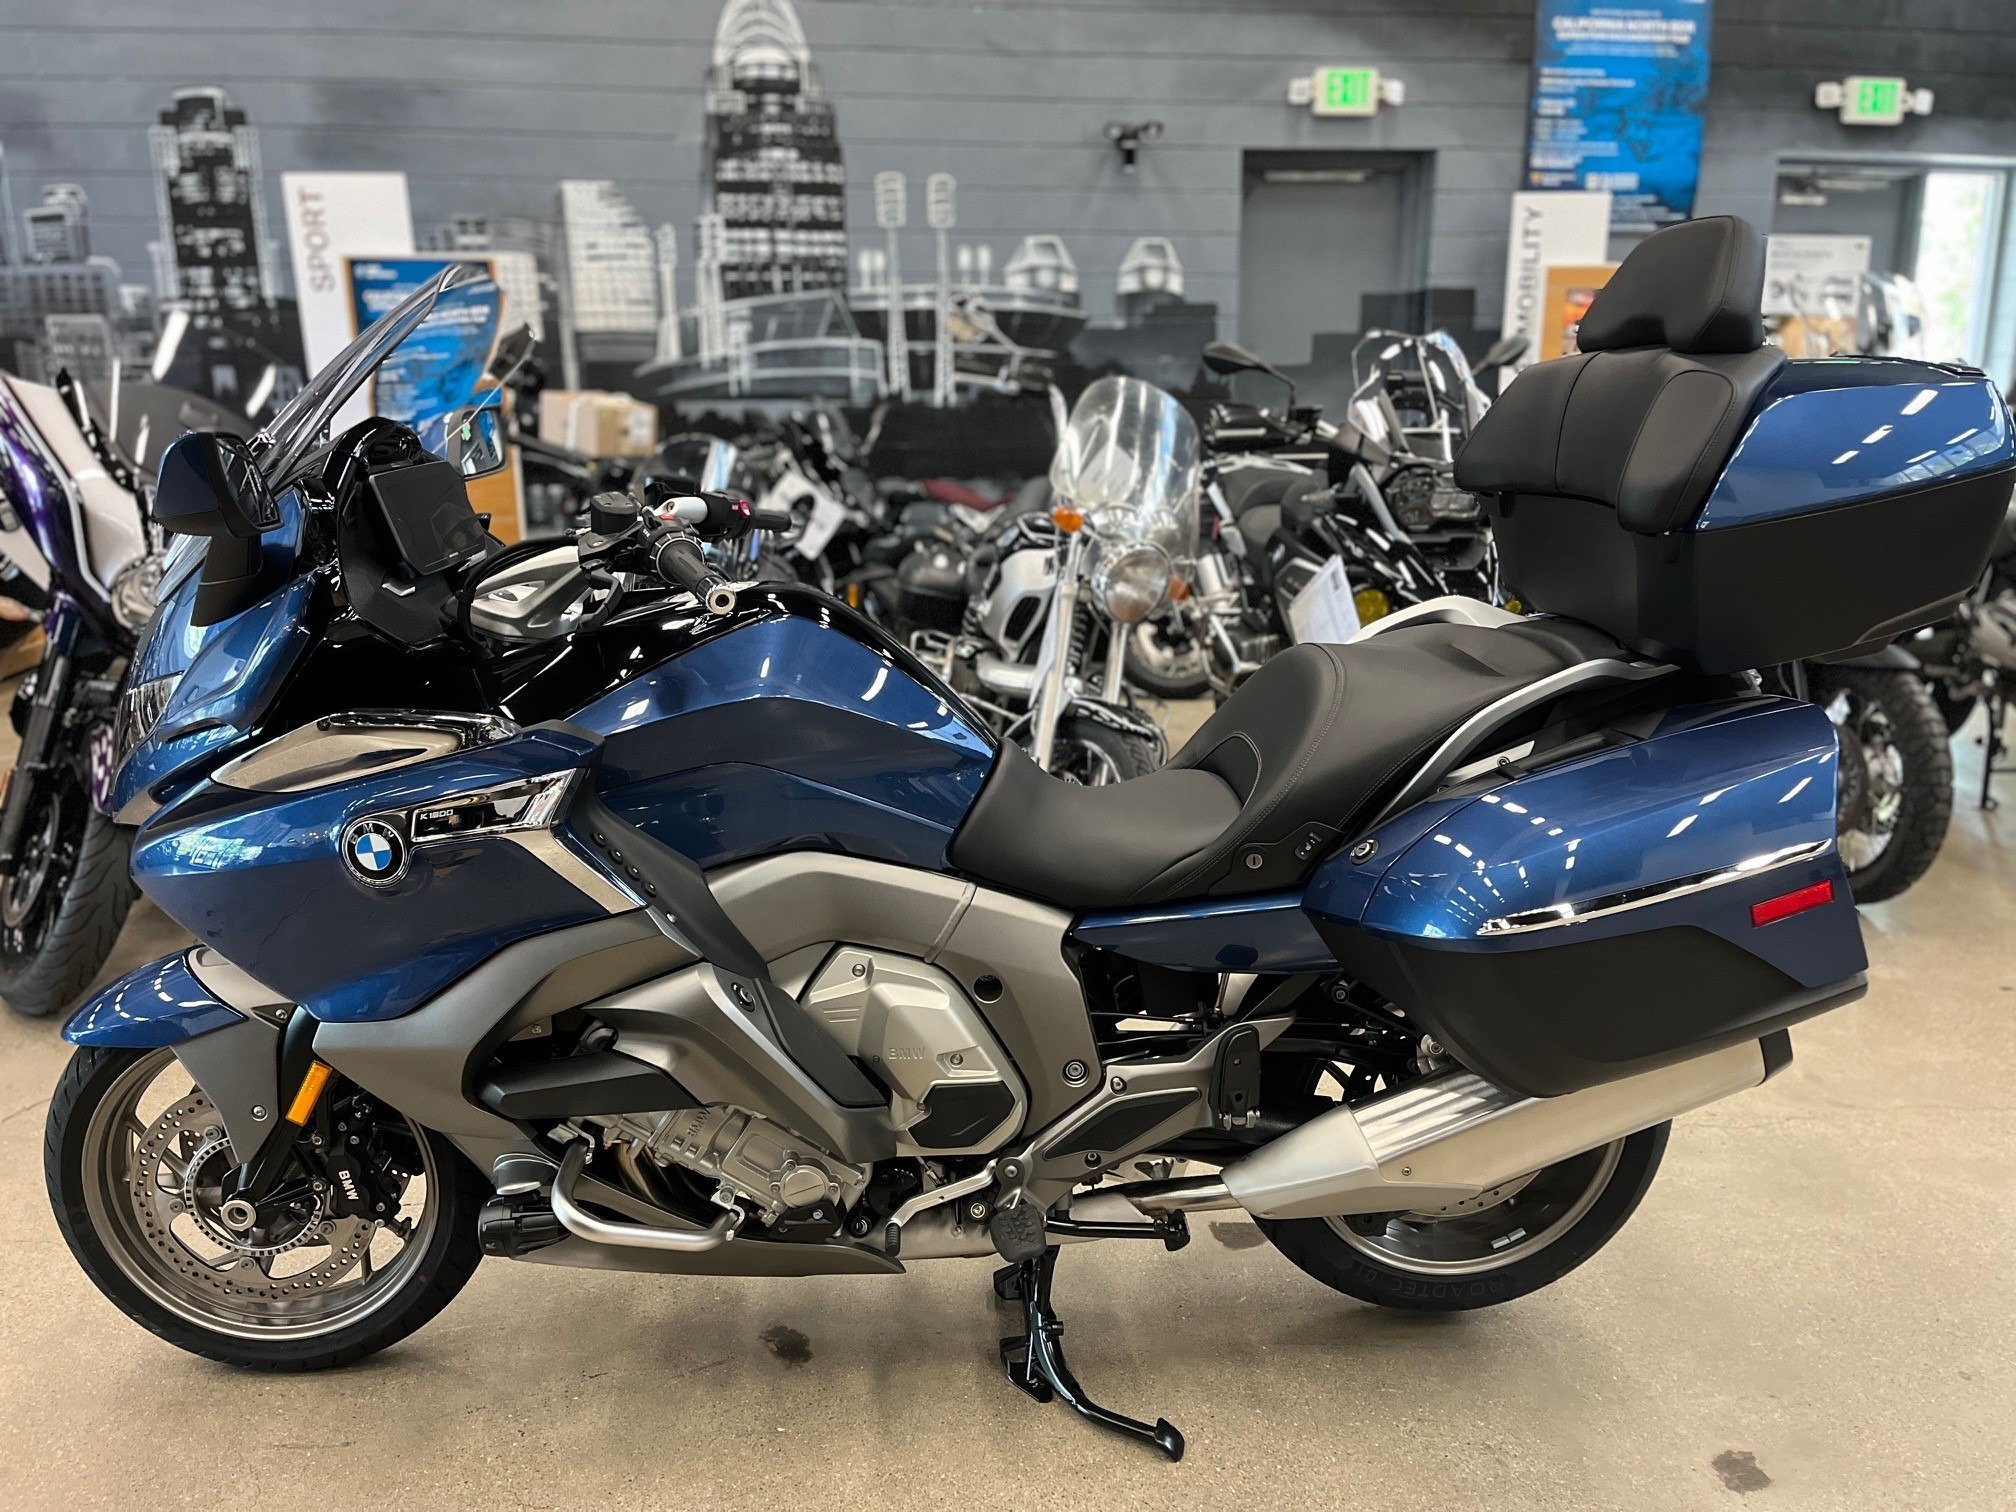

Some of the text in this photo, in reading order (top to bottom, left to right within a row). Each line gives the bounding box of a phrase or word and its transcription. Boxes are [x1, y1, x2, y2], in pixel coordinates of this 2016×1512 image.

[1326, 71, 1371, 106] EXIT
[1857, 80, 1899, 115] EXIT
[298, 186, 336, 293] SPORT
[1517, 205, 1542, 336] MOBILITY
[420, 813, 428, 821] K
[350, 822, 394, 845] BMW
[888, 1046, 926, 1060] BMW
[687, 1107, 711, 1138] BMW
[338, 1170, 360, 1200] BMW
[1389, 1276, 1502, 1298] ROADTEC
